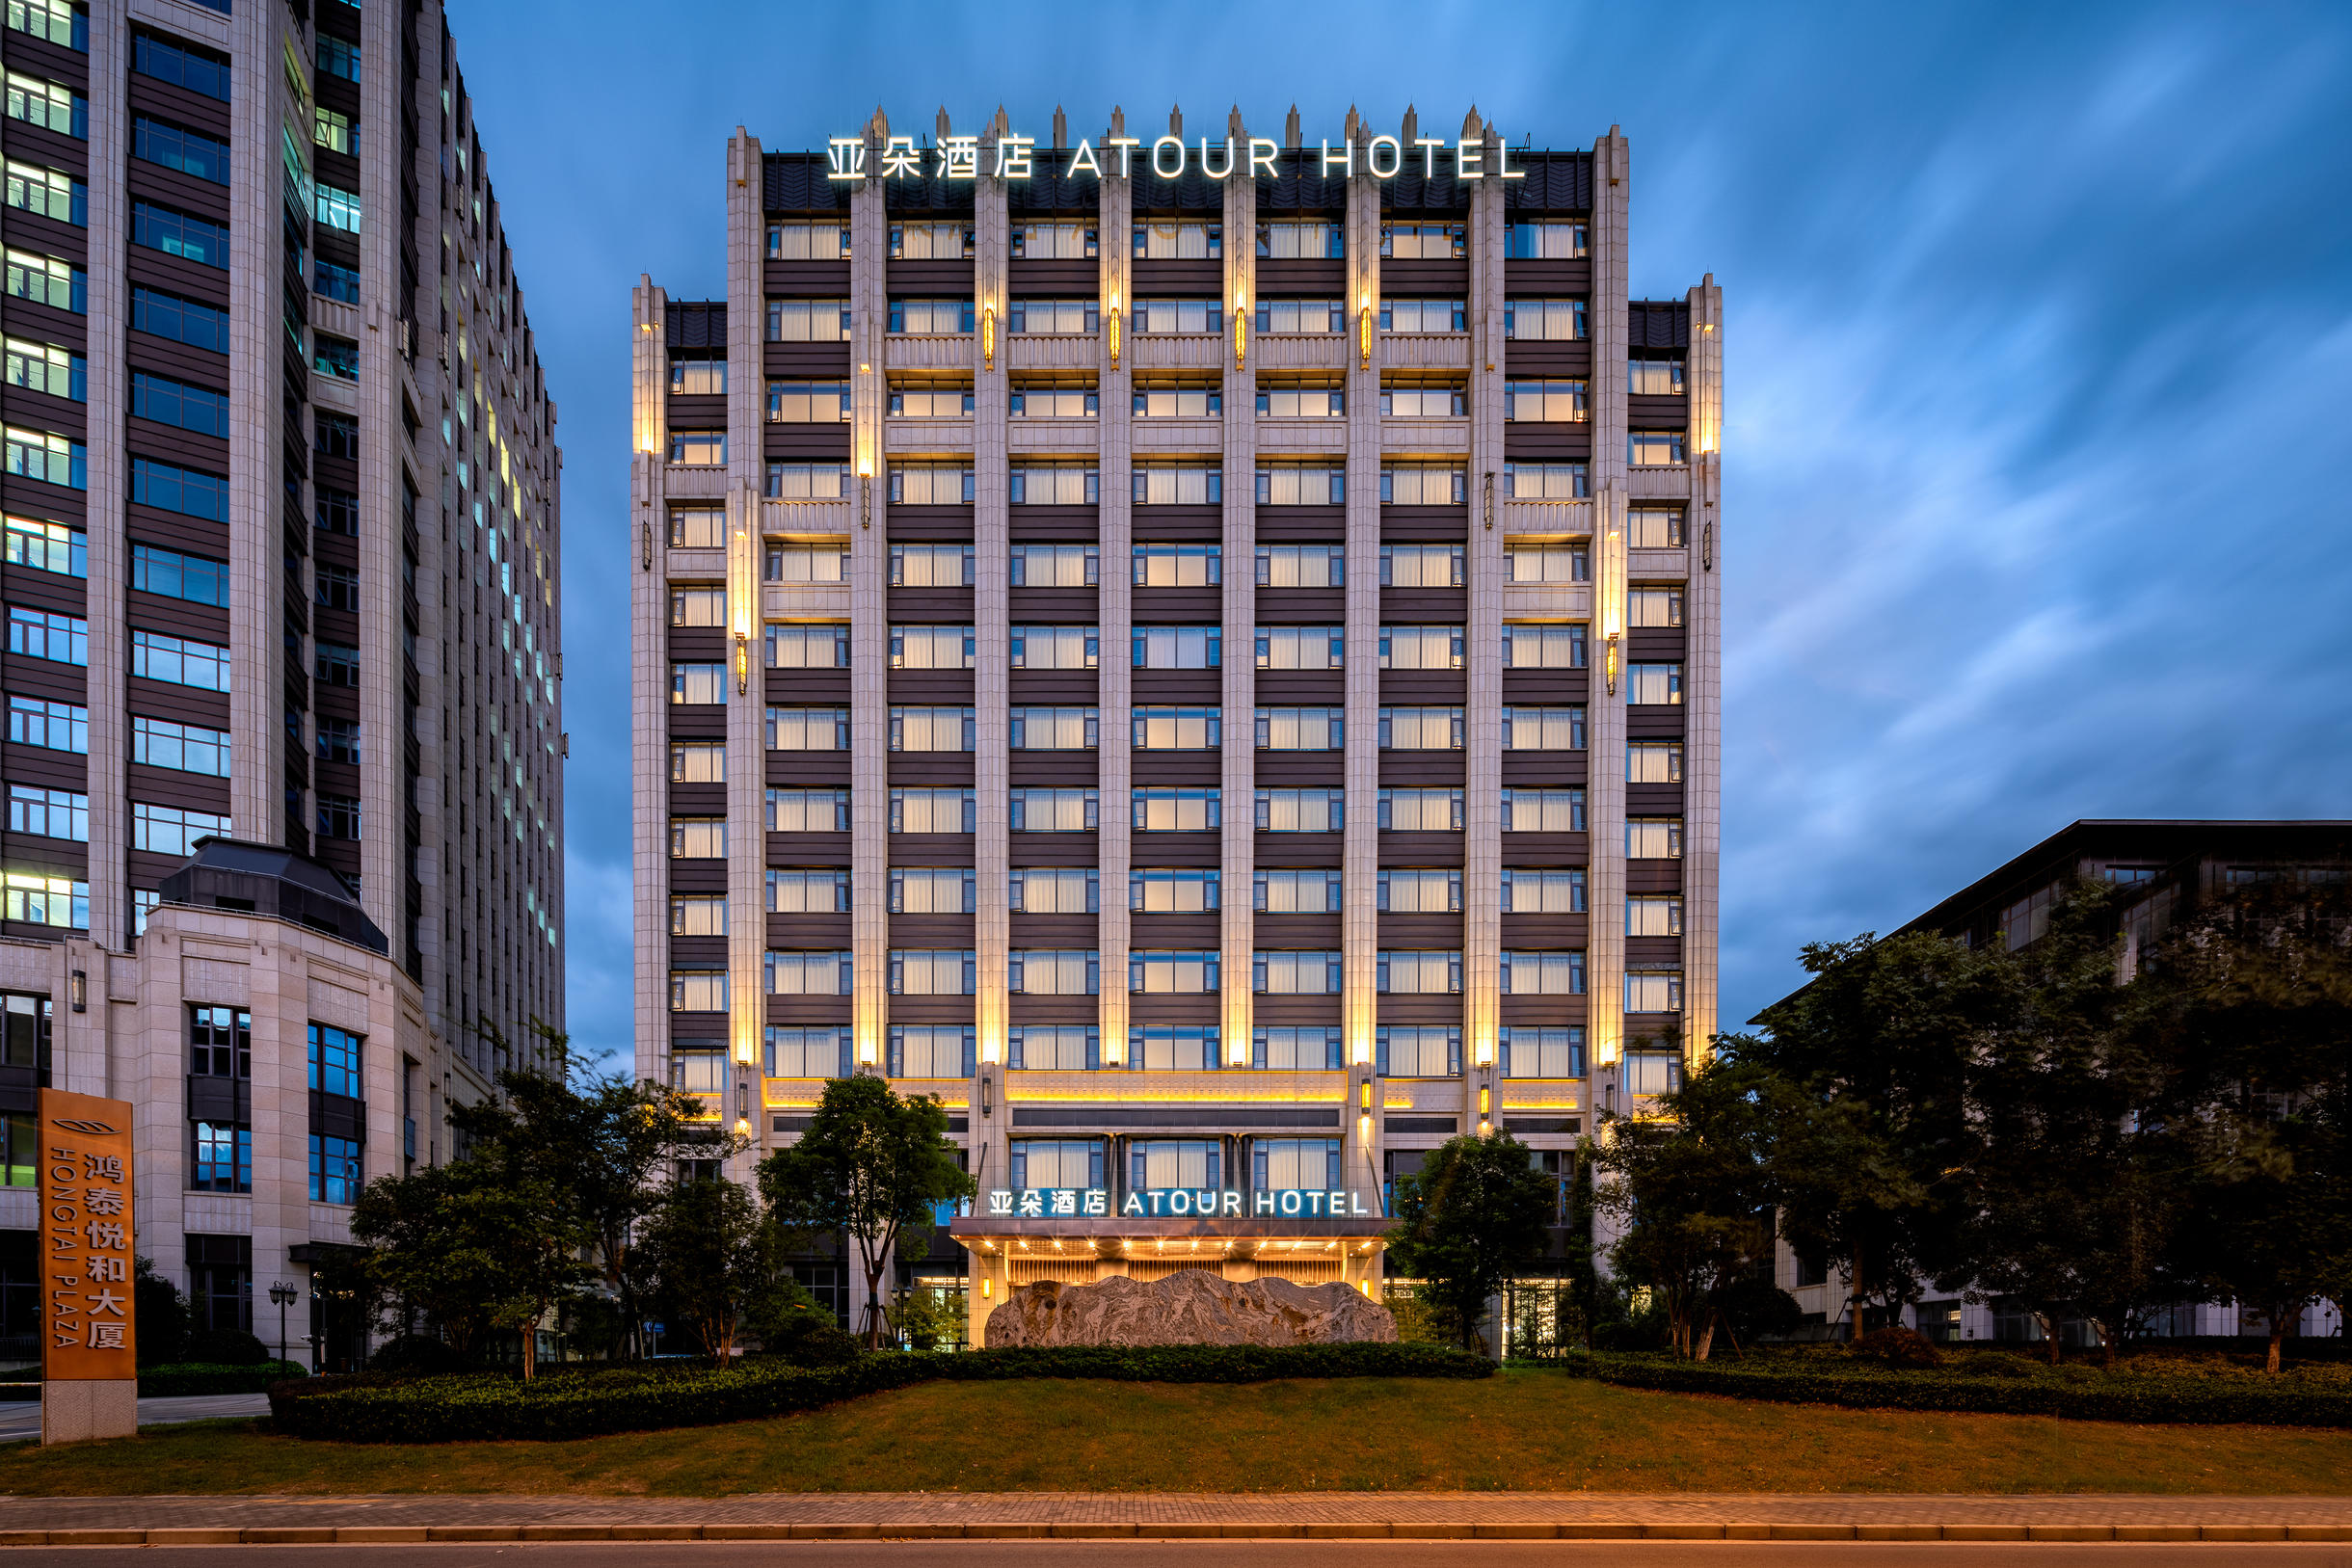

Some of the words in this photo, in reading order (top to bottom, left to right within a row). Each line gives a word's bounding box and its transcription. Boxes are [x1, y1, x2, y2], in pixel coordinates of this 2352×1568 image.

[828, 133, 1035, 178] 亚朵酒店
[1066, 136, 1279, 178] ATOUR
[1323, 136, 1526, 178] HOTEL
[52, 1147, 78, 1262] HONGTAI
[990, 1190, 1106, 1214] 亚朵酒店
[1124, 1191, 1241, 1215] ATOUR
[1256, 1190, 1368, 1215] HOTEL
[85, 1153, 127, 1350] 鸿泰悦和大厦
[53, 1274, 80, 1349] PLAZA
